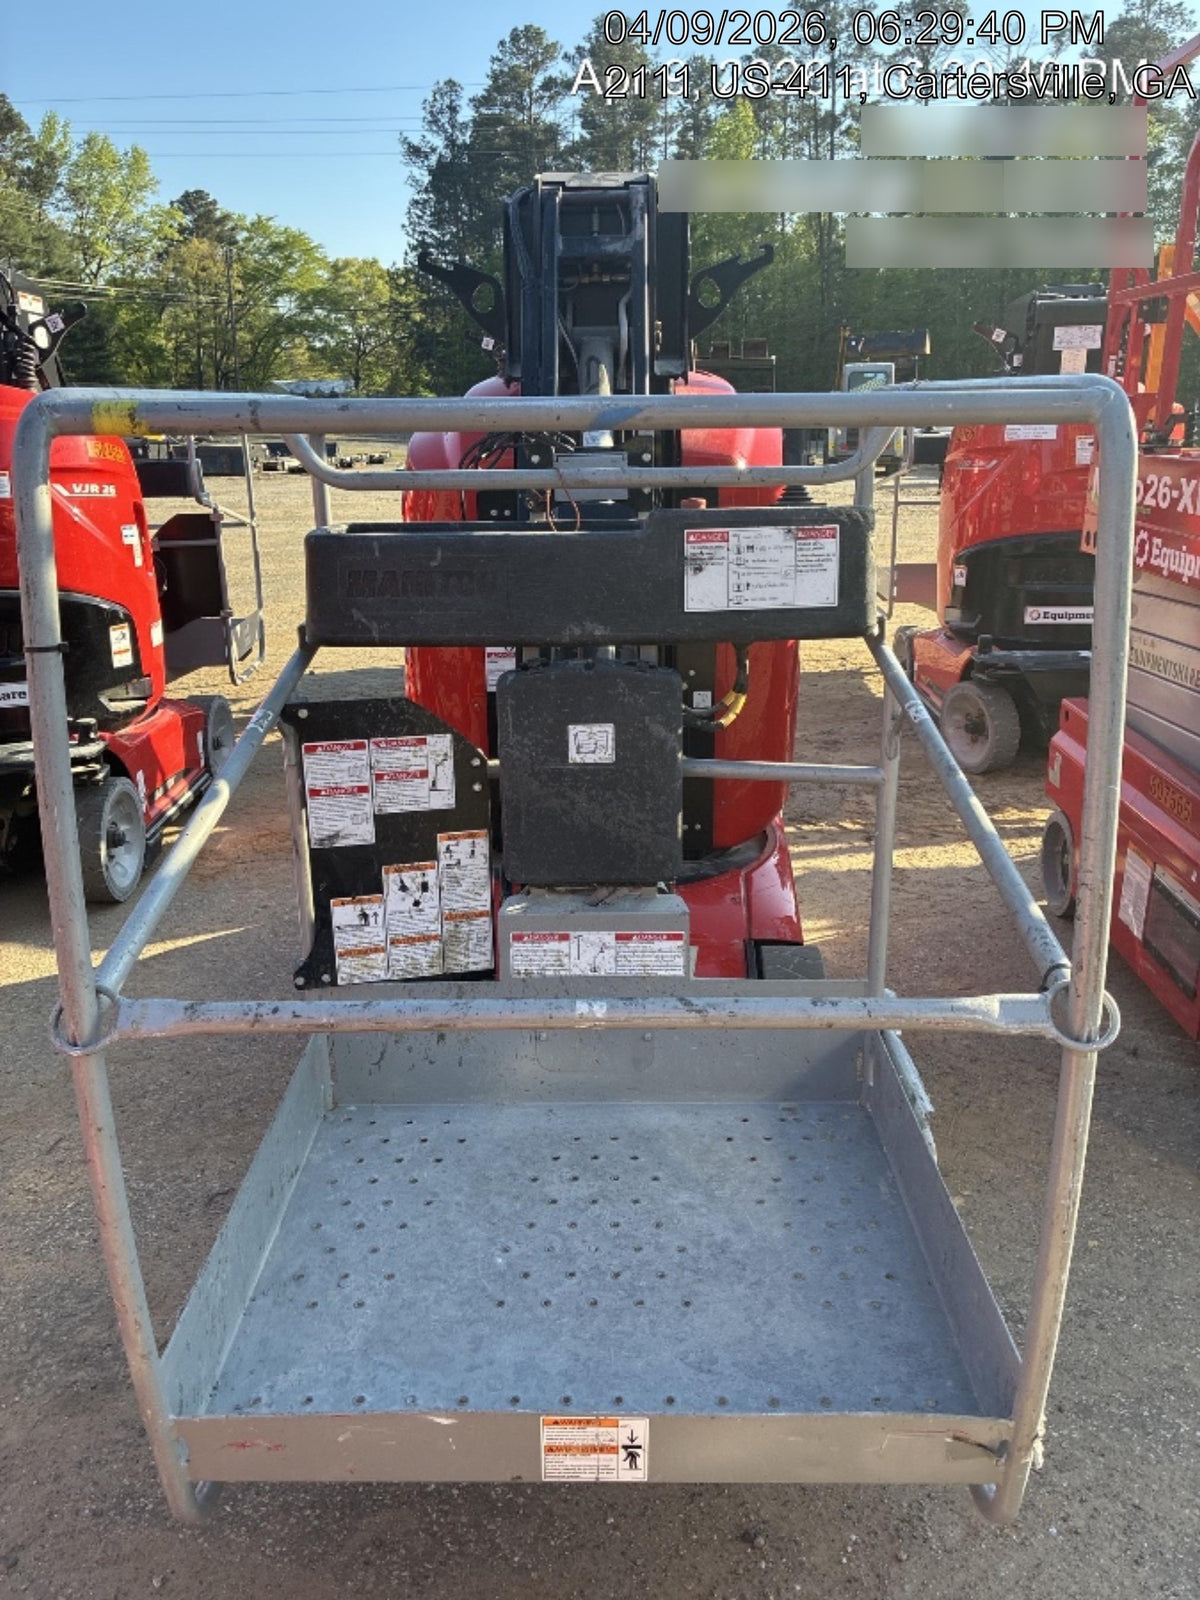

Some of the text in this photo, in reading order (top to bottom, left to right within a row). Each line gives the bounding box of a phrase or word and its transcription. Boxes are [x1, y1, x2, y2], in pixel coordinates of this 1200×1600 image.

[72, 483, 101, 494] VJR
[1135, 473, 1200, 517] 26-X
[1150, 537, 1200, 583] Equip
